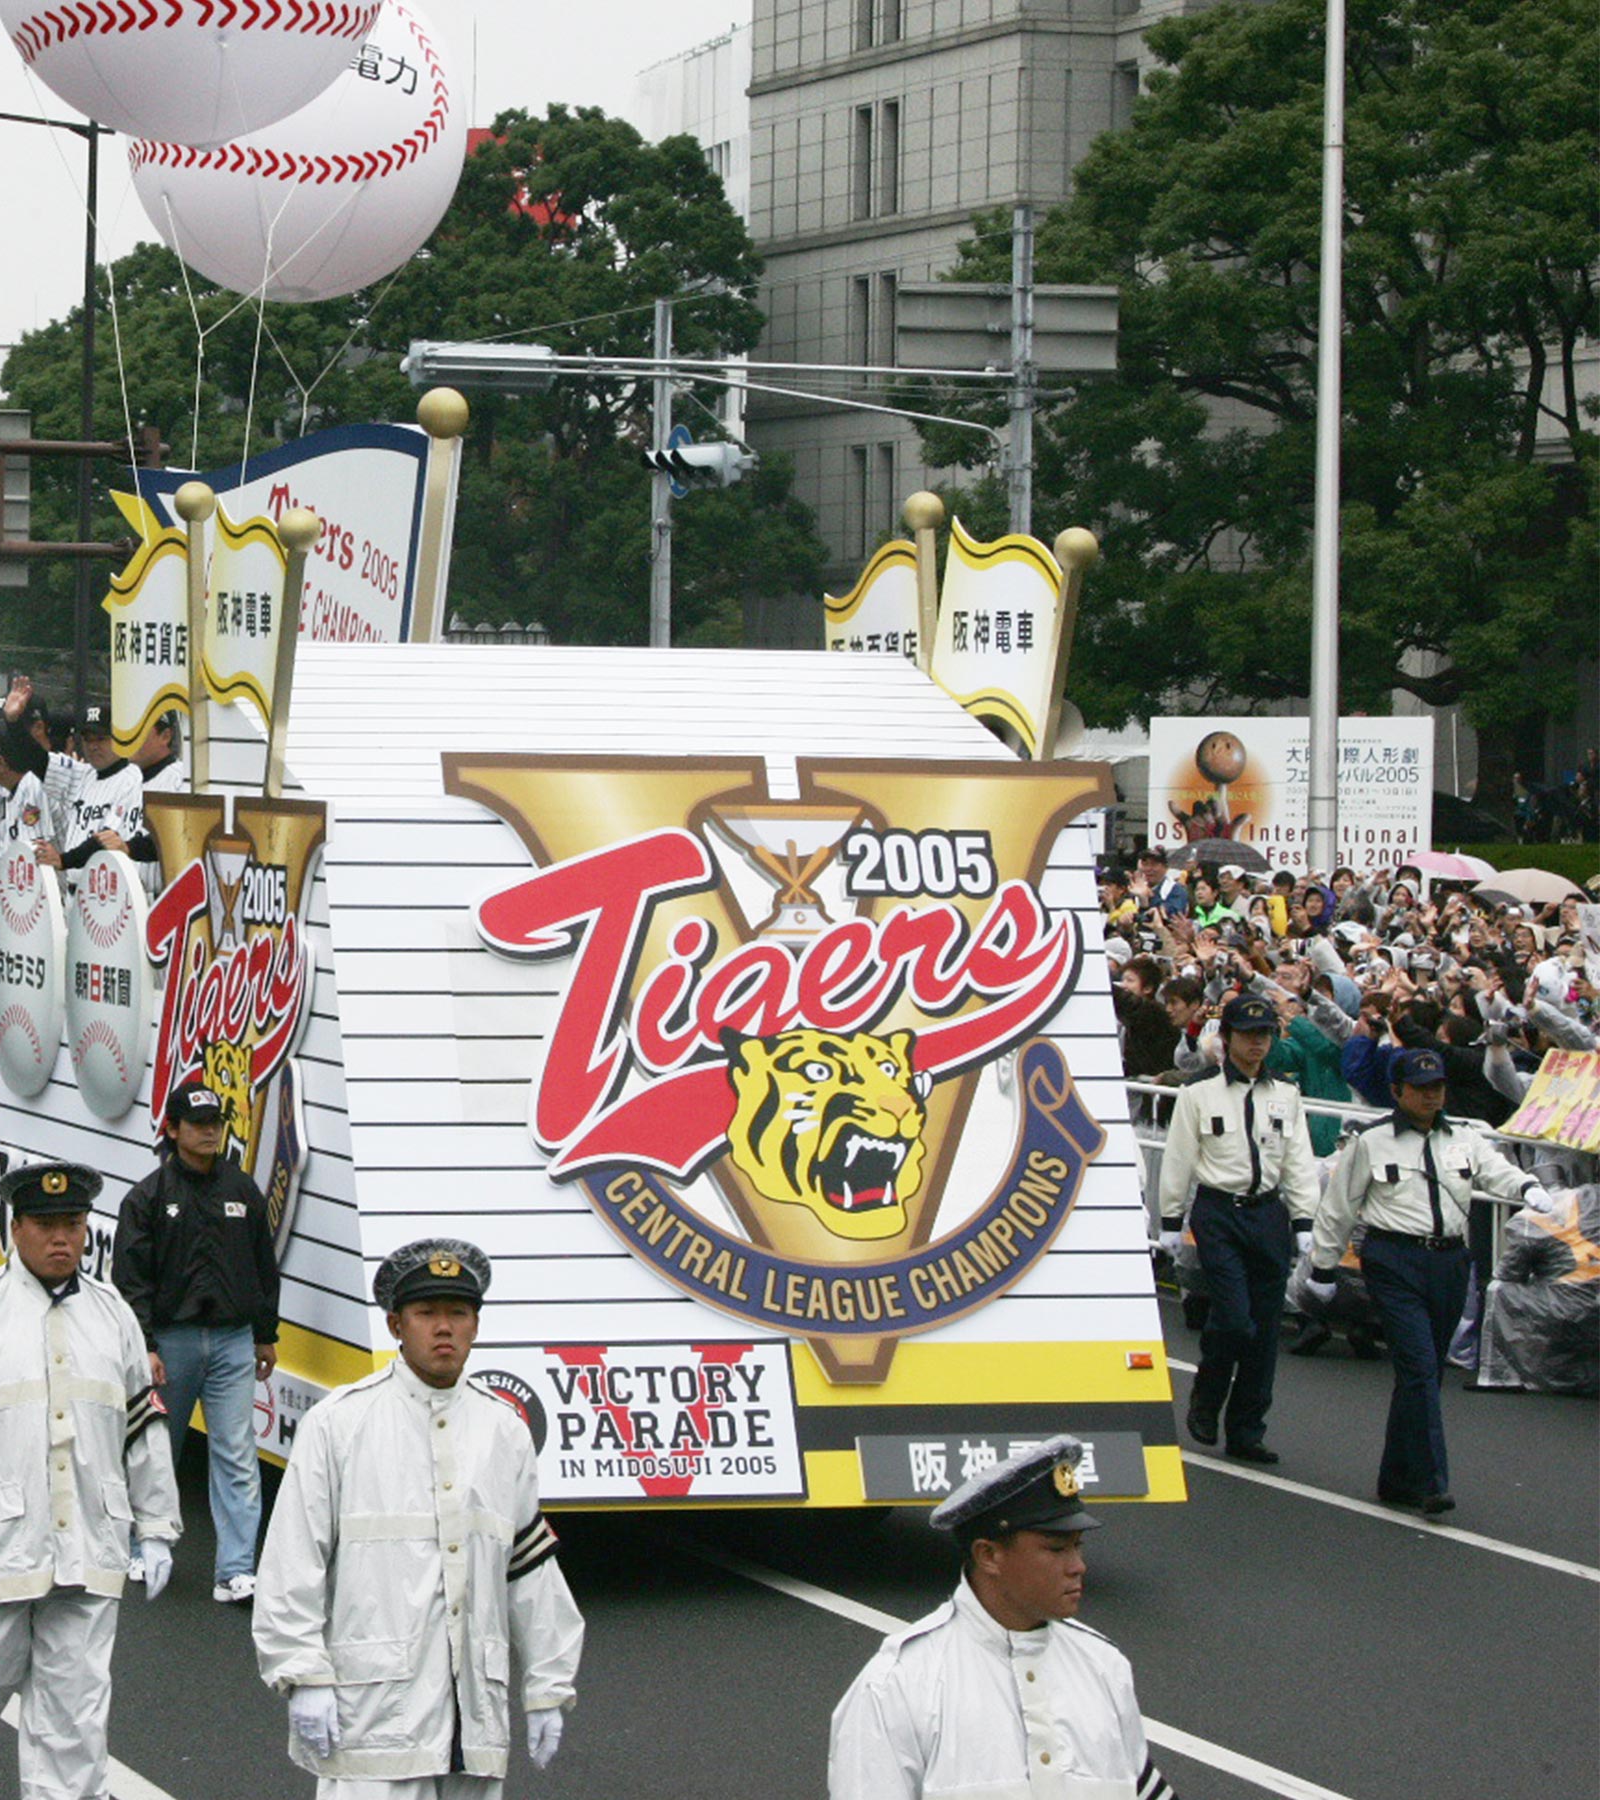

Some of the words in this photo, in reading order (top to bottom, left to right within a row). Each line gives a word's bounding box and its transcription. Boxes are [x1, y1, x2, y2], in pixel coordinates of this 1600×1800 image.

[349, 44, 418, 95] 電力
[362, 541, 398, 601] 2005
[216, 592, 272, 639] 阪神電車
[952, 610, 1034, 654] 阪神電車
[114, 621, 188, 667] 阪神百貨店
[1249, 824, 1418, 844] Intertional
[847, 834, 992, 895] 2005
[242, 866, 286, 923] 2005
[75, 960, 132, 1008] 朝日新聞
[146, 857, 304, 1143] Tigers
[476, 826, 1082, 1180] Tigers
[602, 1169, 749, 1301] CENTRAL
[763, 1269, 906, 1322] LEAGUE
[907, 1149, 1071, 1311] CHAMPIONS
[546, 1364, 765, 1405] VICTORY
[557, 1409, 774, 1451] PARADE
[560, 1459, 585, 1478] IN
[596, 1456, 712, 1478] MIDOSUJI
[720, 1456, 777, 1476] 2005
